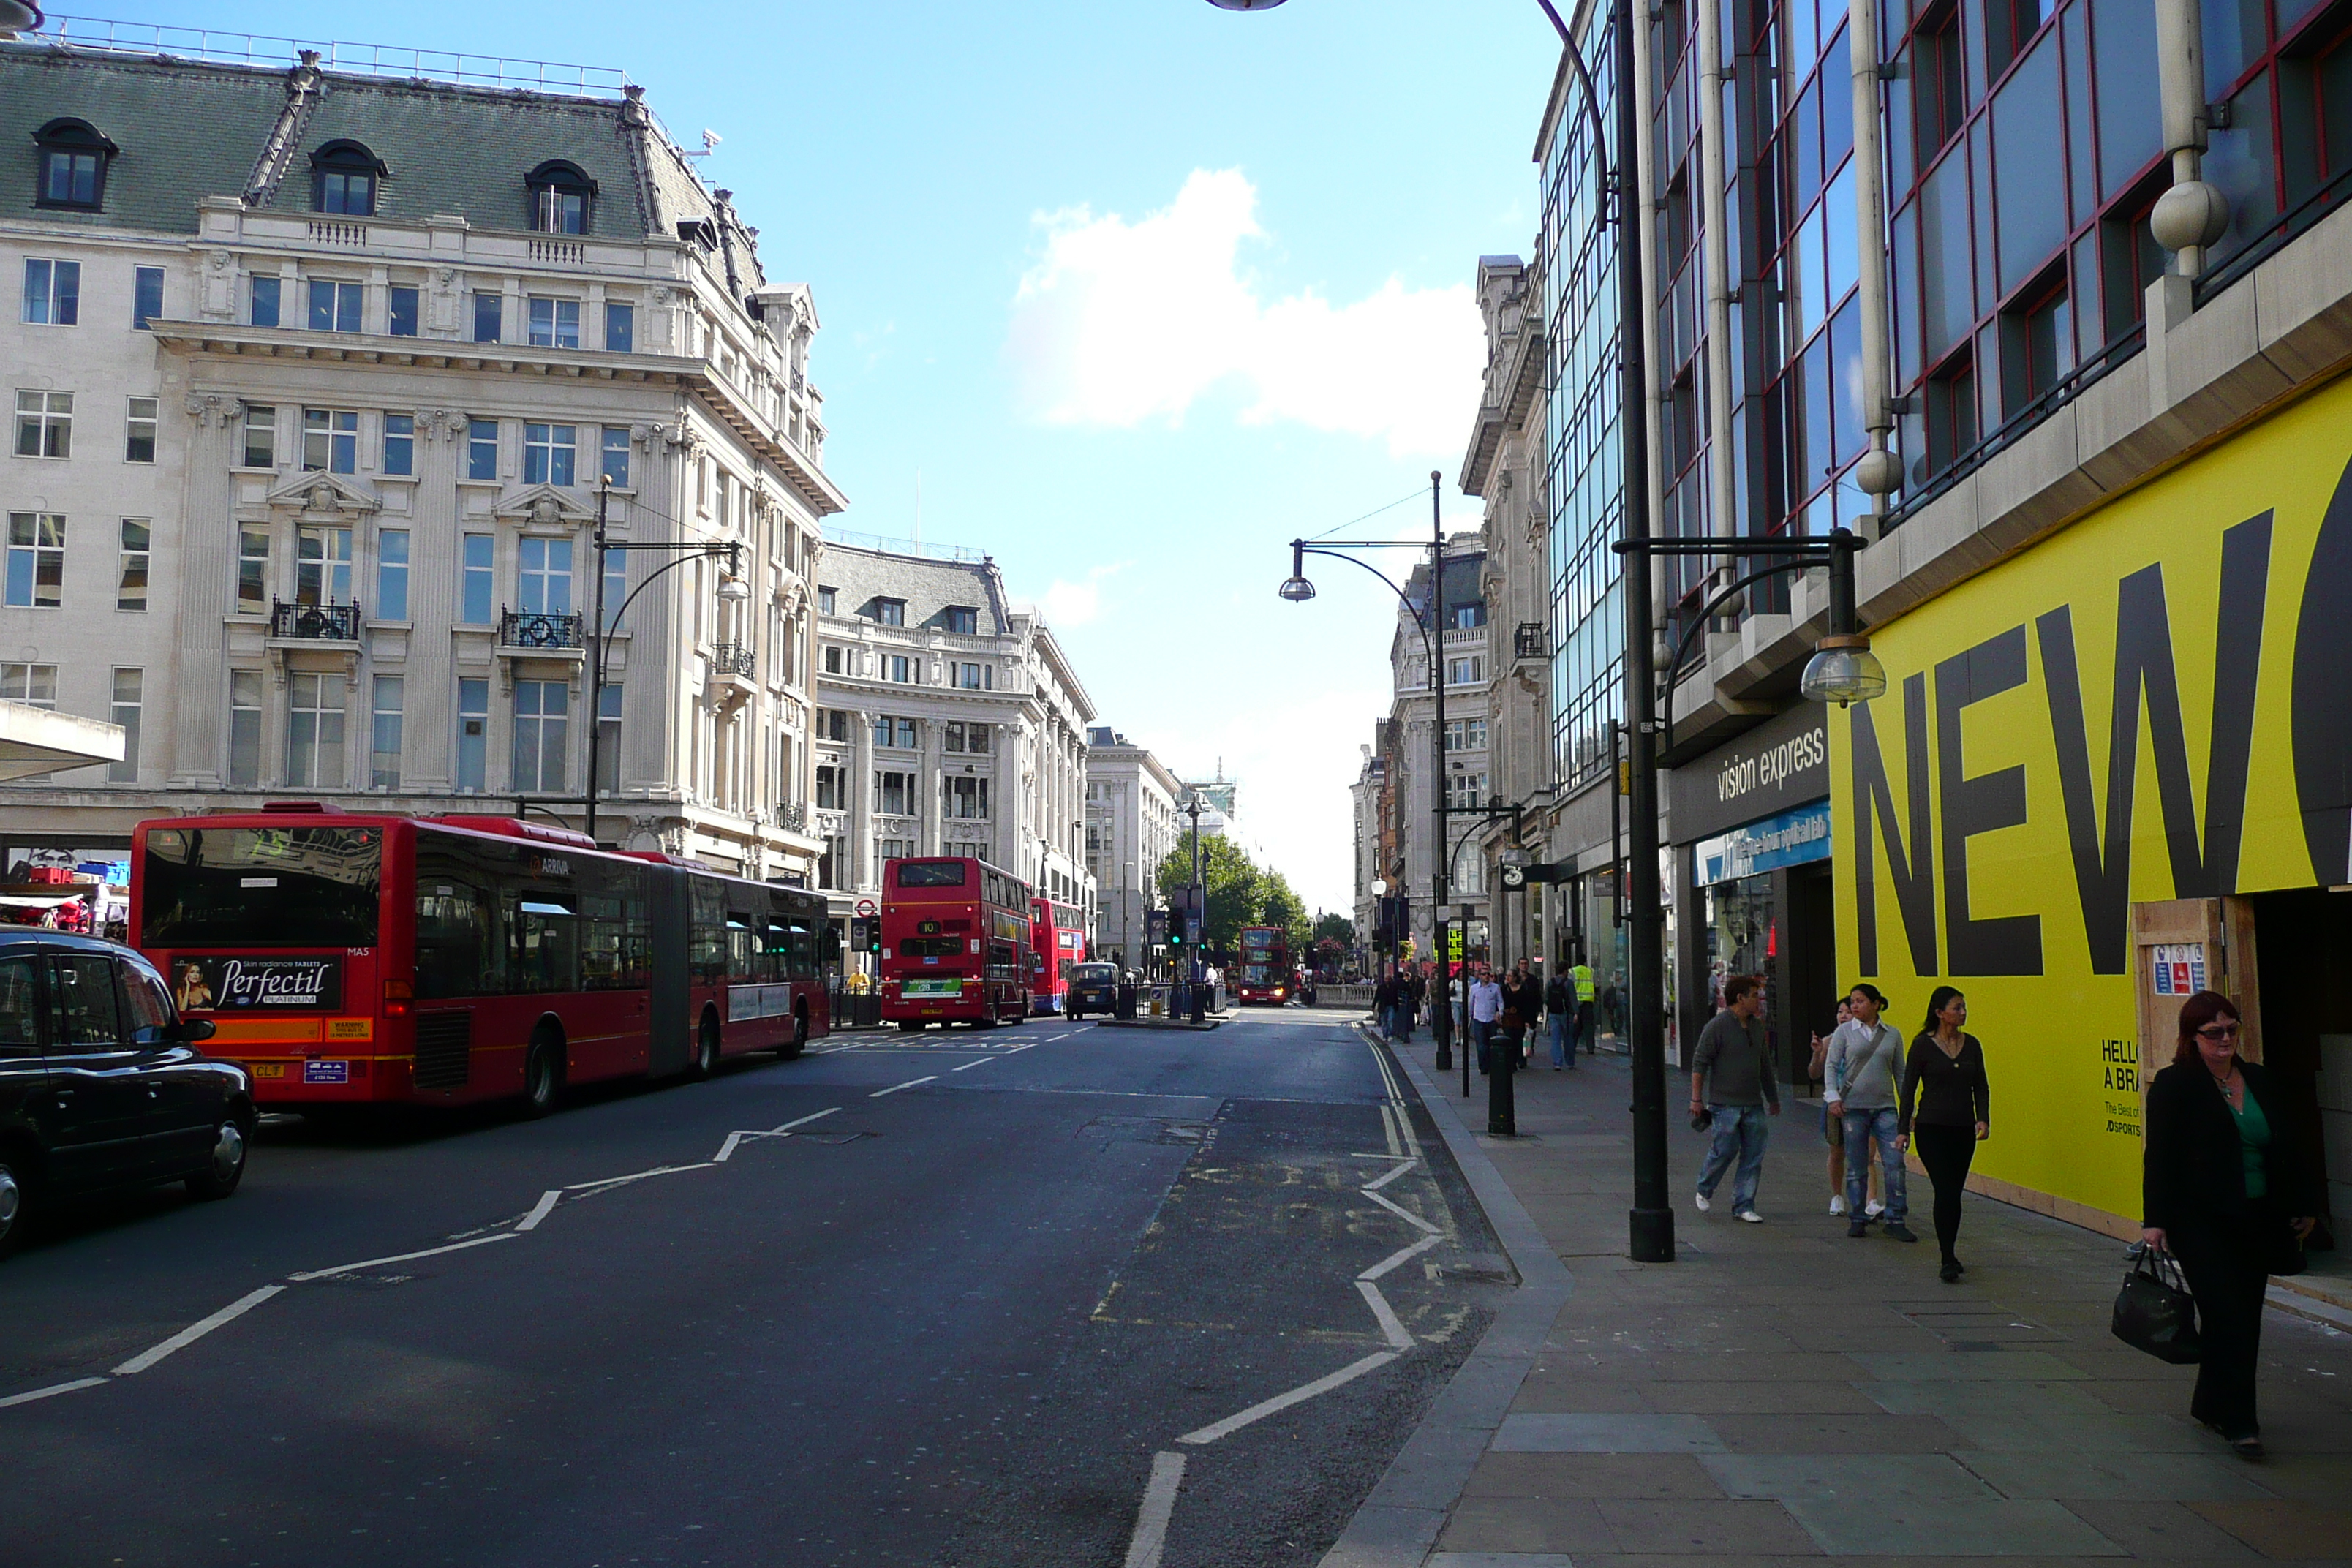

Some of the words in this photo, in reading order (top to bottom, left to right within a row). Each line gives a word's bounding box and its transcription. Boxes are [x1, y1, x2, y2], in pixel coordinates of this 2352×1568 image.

[1718, 755, 1756, 802] vision
[1760, 728, 1825, 791] express
[542, 858, 569, 875] ARRIVA
[924, 923, 934, 932] 10
[347, 947, 369, 957] MA5
[217, 960, 329, 1007] Perfectil
[264, 995, 316, 1003] PLATINUM
[2104, 1066, 2114, 1090] A
[2105, 1101, 2117, 1115] The
[2117, 1103, 2133, 1117] Best
[2133, 1105, 2140, 1118] of
